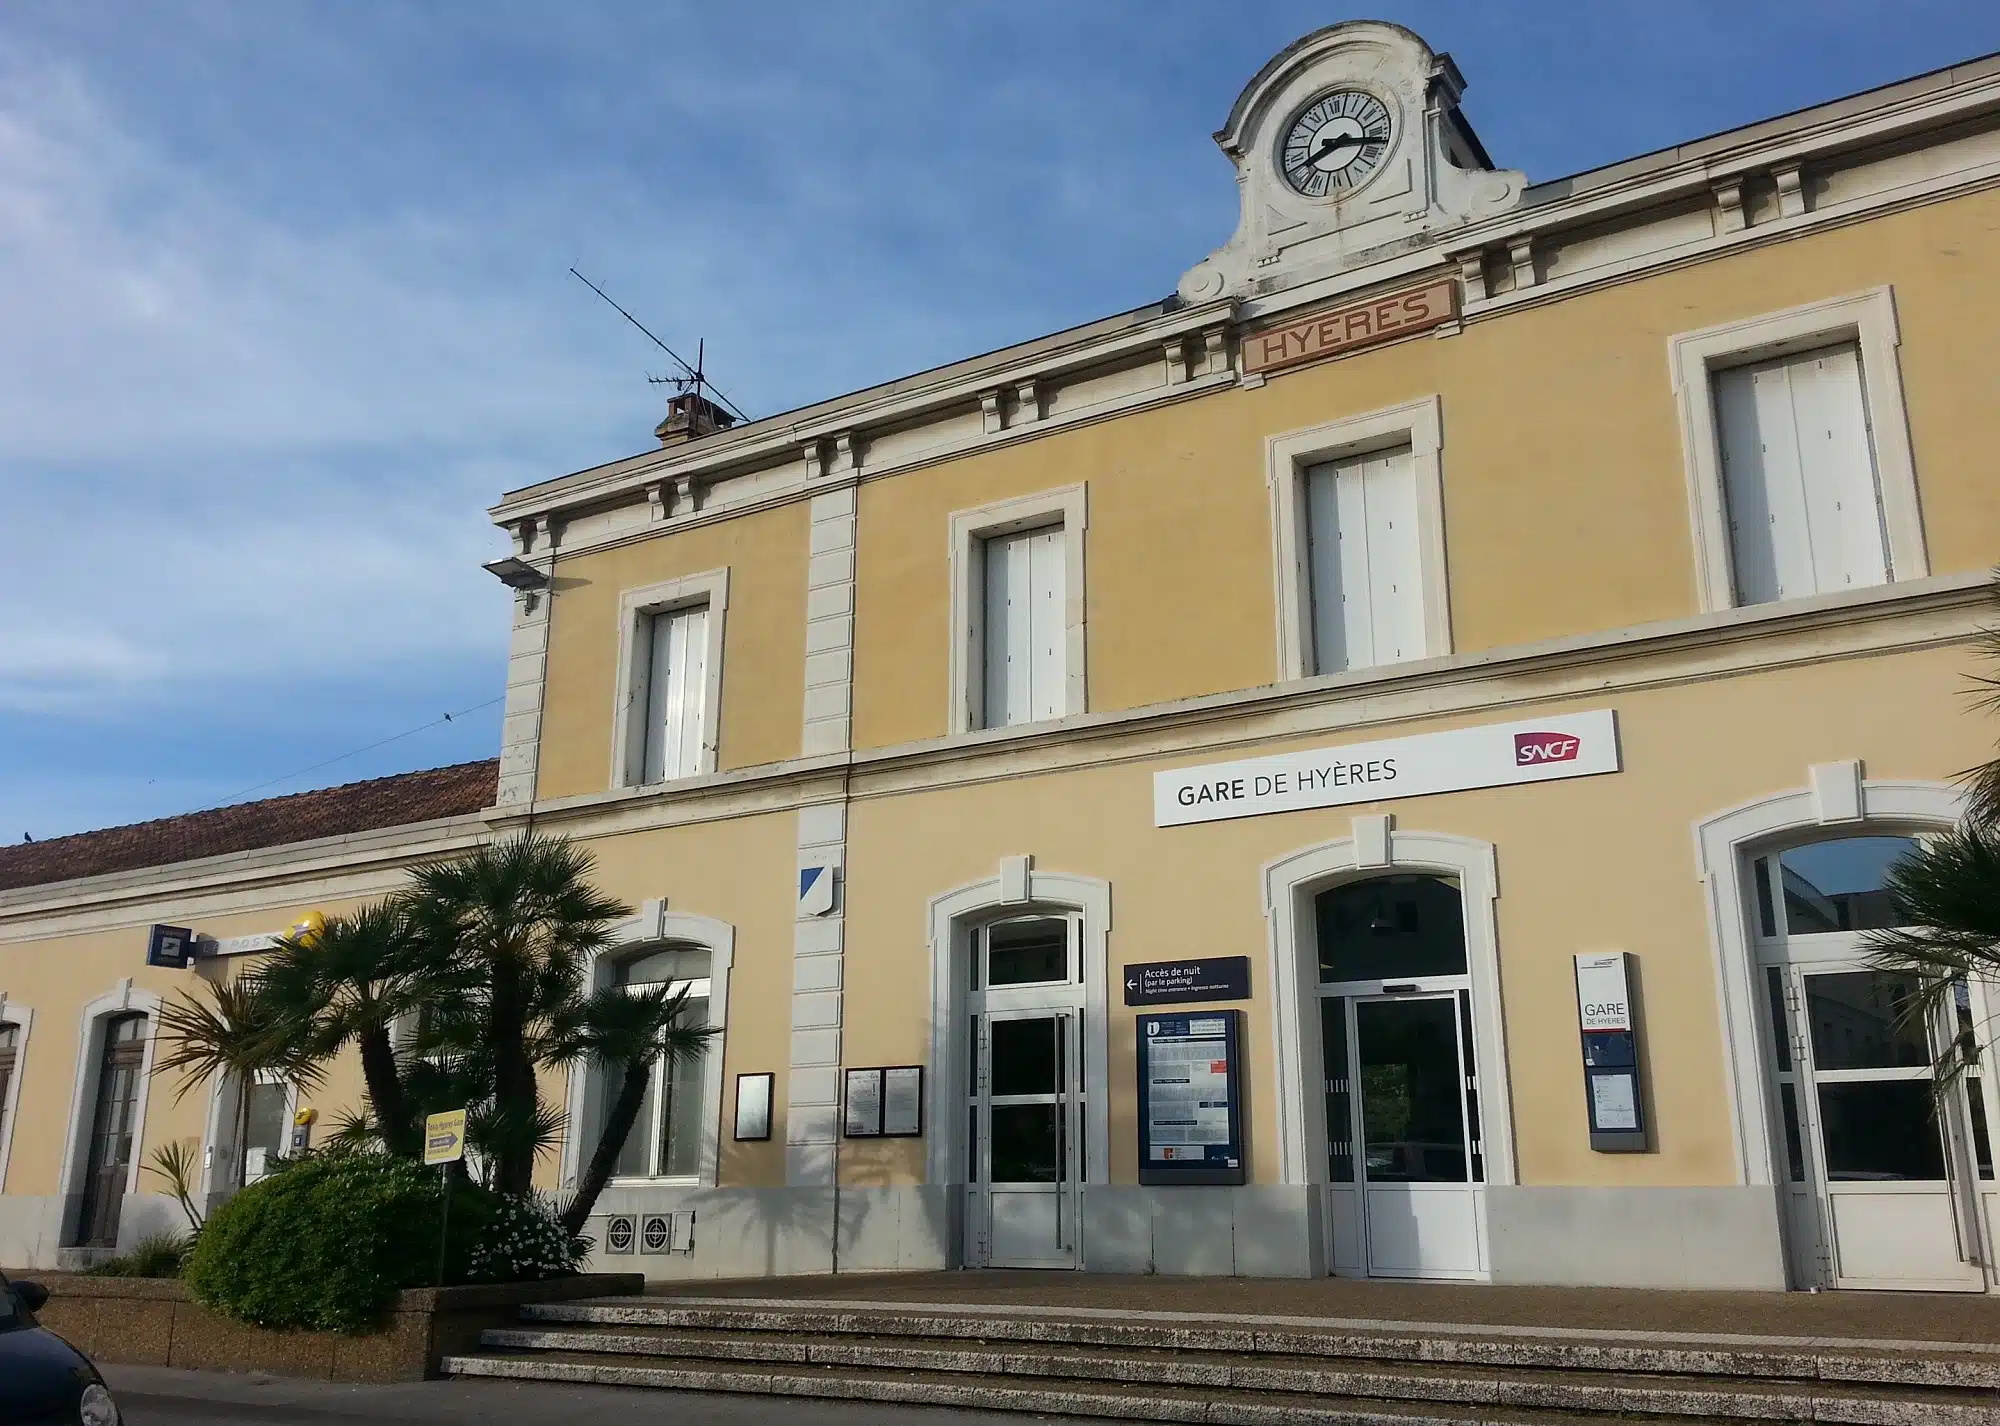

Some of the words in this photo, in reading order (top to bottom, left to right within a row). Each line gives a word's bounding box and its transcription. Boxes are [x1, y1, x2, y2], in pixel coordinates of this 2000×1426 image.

[1328, 99, 1341, 115] XII
[1262, 293, 1430, 364] HYERES
[1518, 739, 1577, 763] SNCF
[1177, 778, 1245, 807] GARE
[1254, 773, 1288, 797] DE
[1297, 758, 1398, 791] HYÈRES
[1144, 968, 1169, 979] Accès
[1170, 967, 1182, 977] de
[1183, 965, 1201, 976] nuit
[1144, 979, 1158, 988] (par
[1158, 978, 1166, 986] le
[1166, 976, 1193, 987] parking)
[1584, 1002, 1625, 1016] GARE
